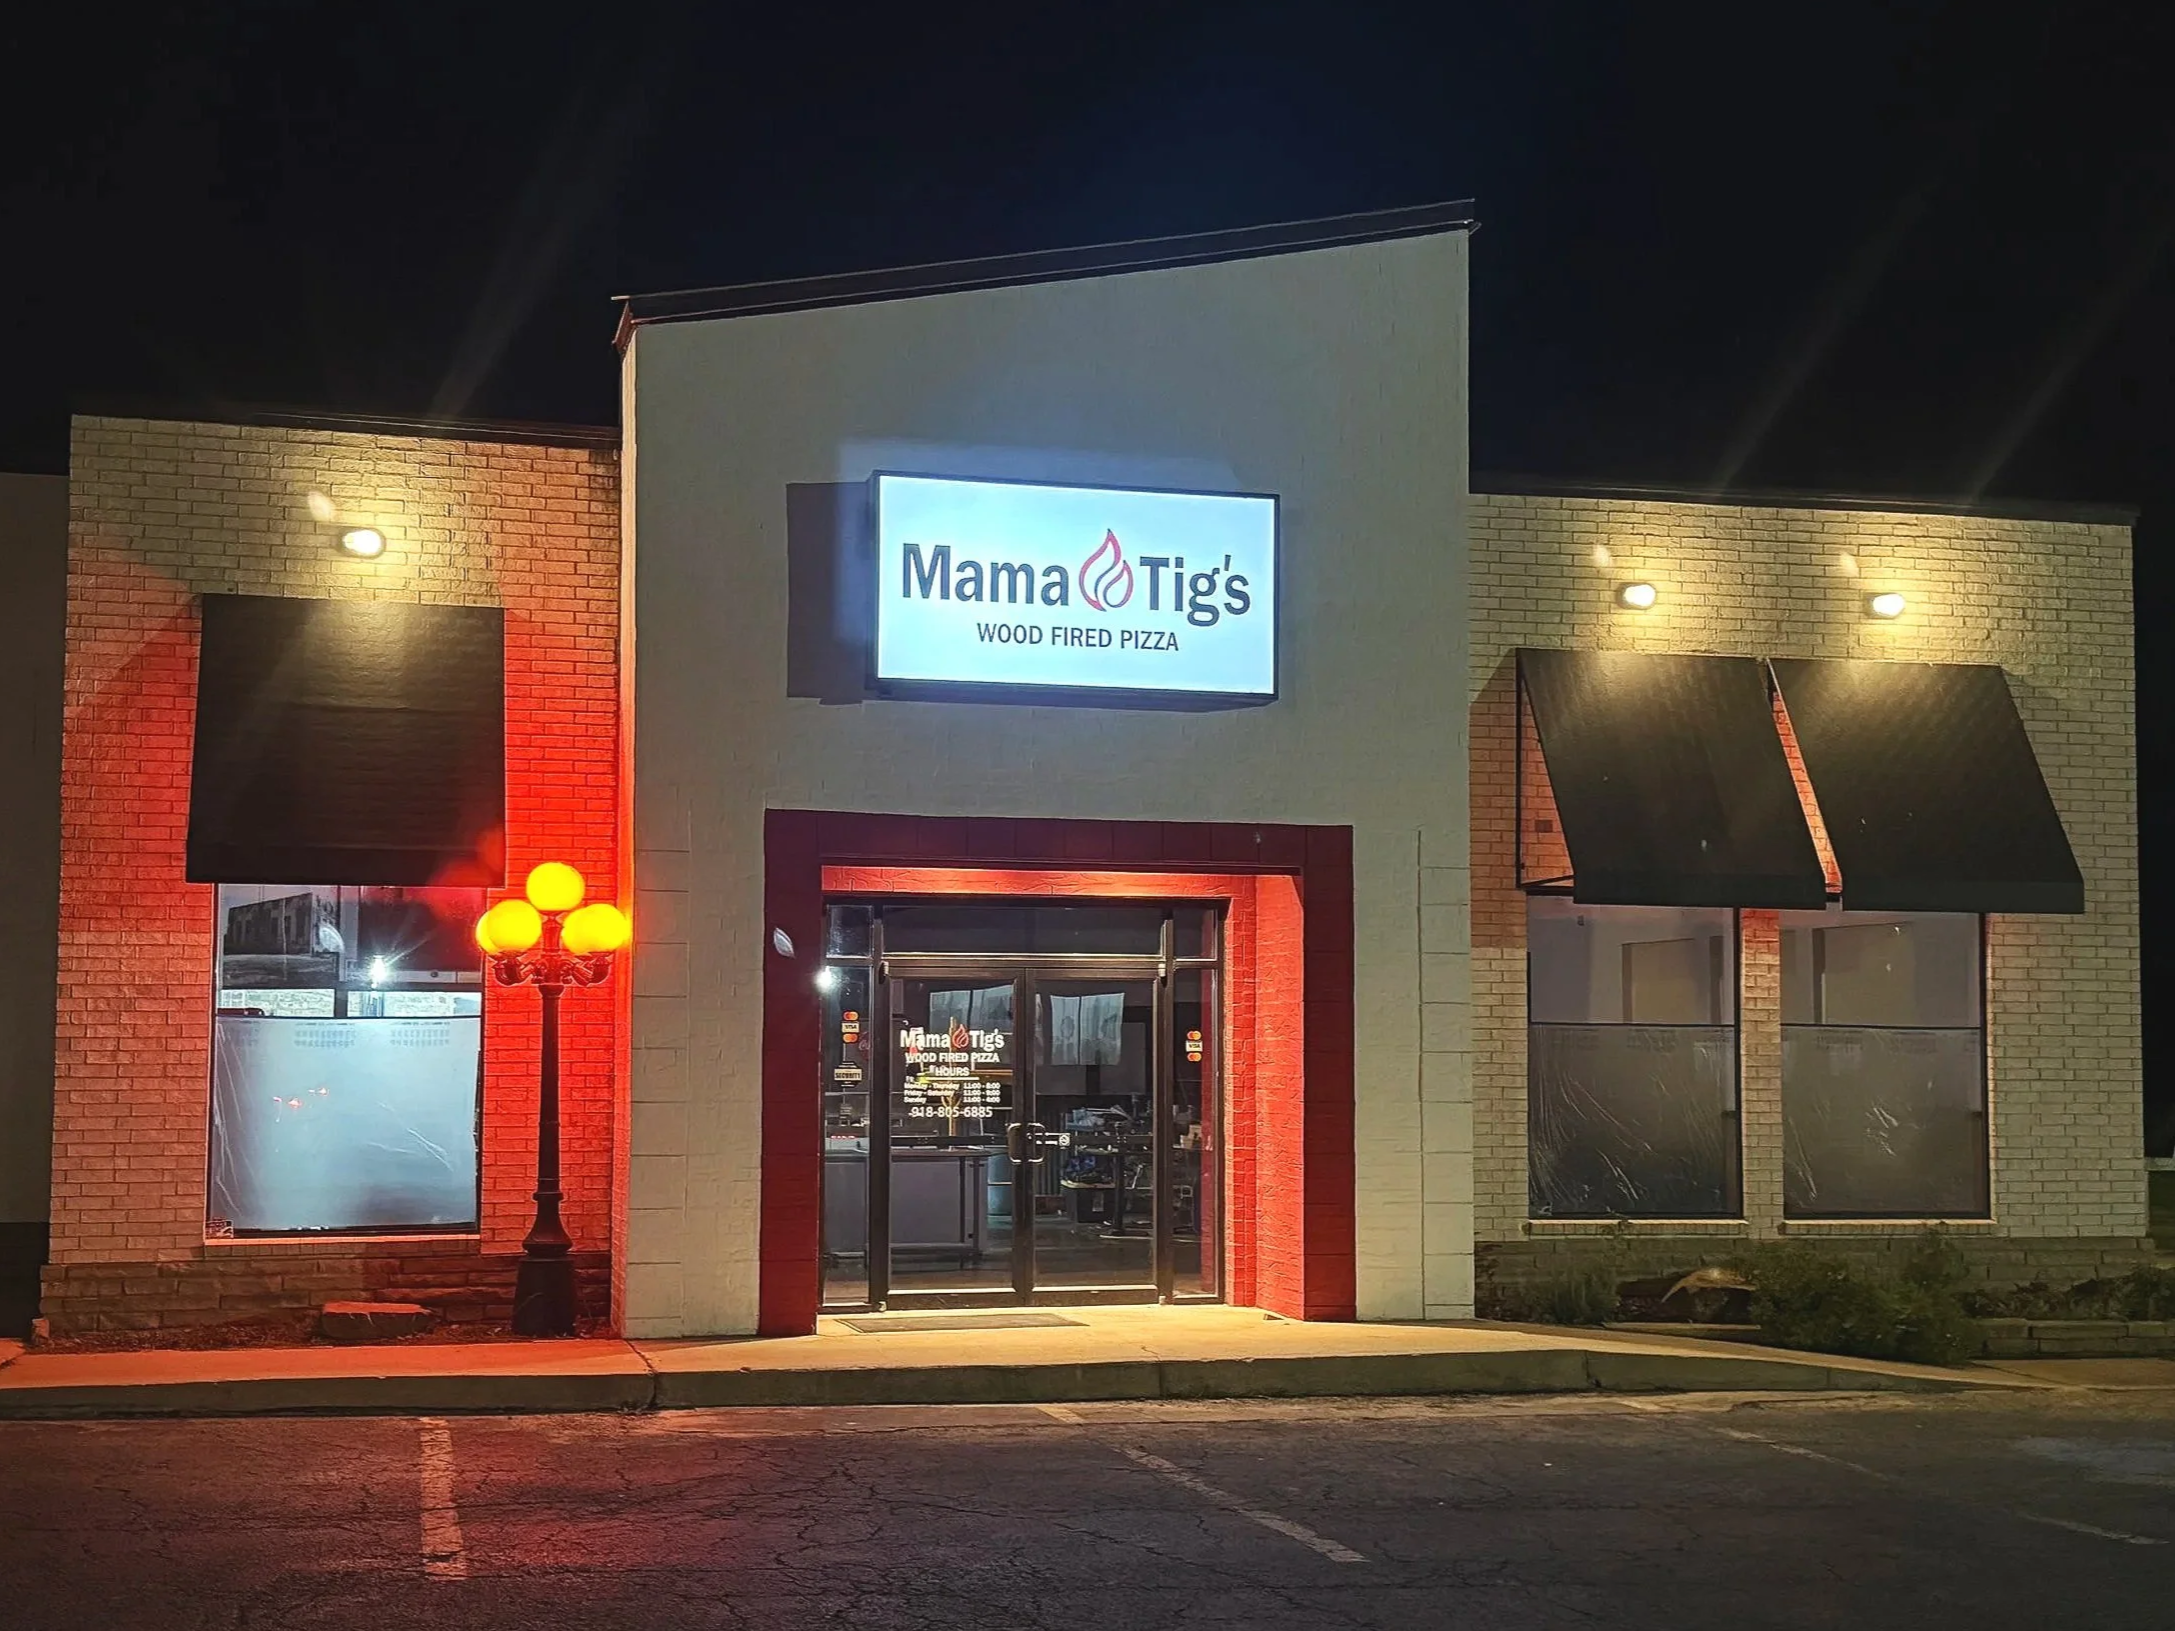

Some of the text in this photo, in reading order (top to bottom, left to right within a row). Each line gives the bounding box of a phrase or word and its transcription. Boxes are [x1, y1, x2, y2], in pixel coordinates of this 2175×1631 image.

[902, 543, 1251, 627] Mama Tig's
[976, 623, 1179, 651] WOOD FIRED PIZZA
[900, 1028, 1005, 1052] Mama Tig's
[905, 1052, 1000, 1063] WOOD FIRED PIZZA
[935, 1066, 970, 1076] HOURS
[904, 1089, 922, 1097] Friday
[927, 1089, 955, 1097] Saturday
[904, 1096, 927, 1104] Sunday
[910, 1106, 993, 1118] 918-805-6885
